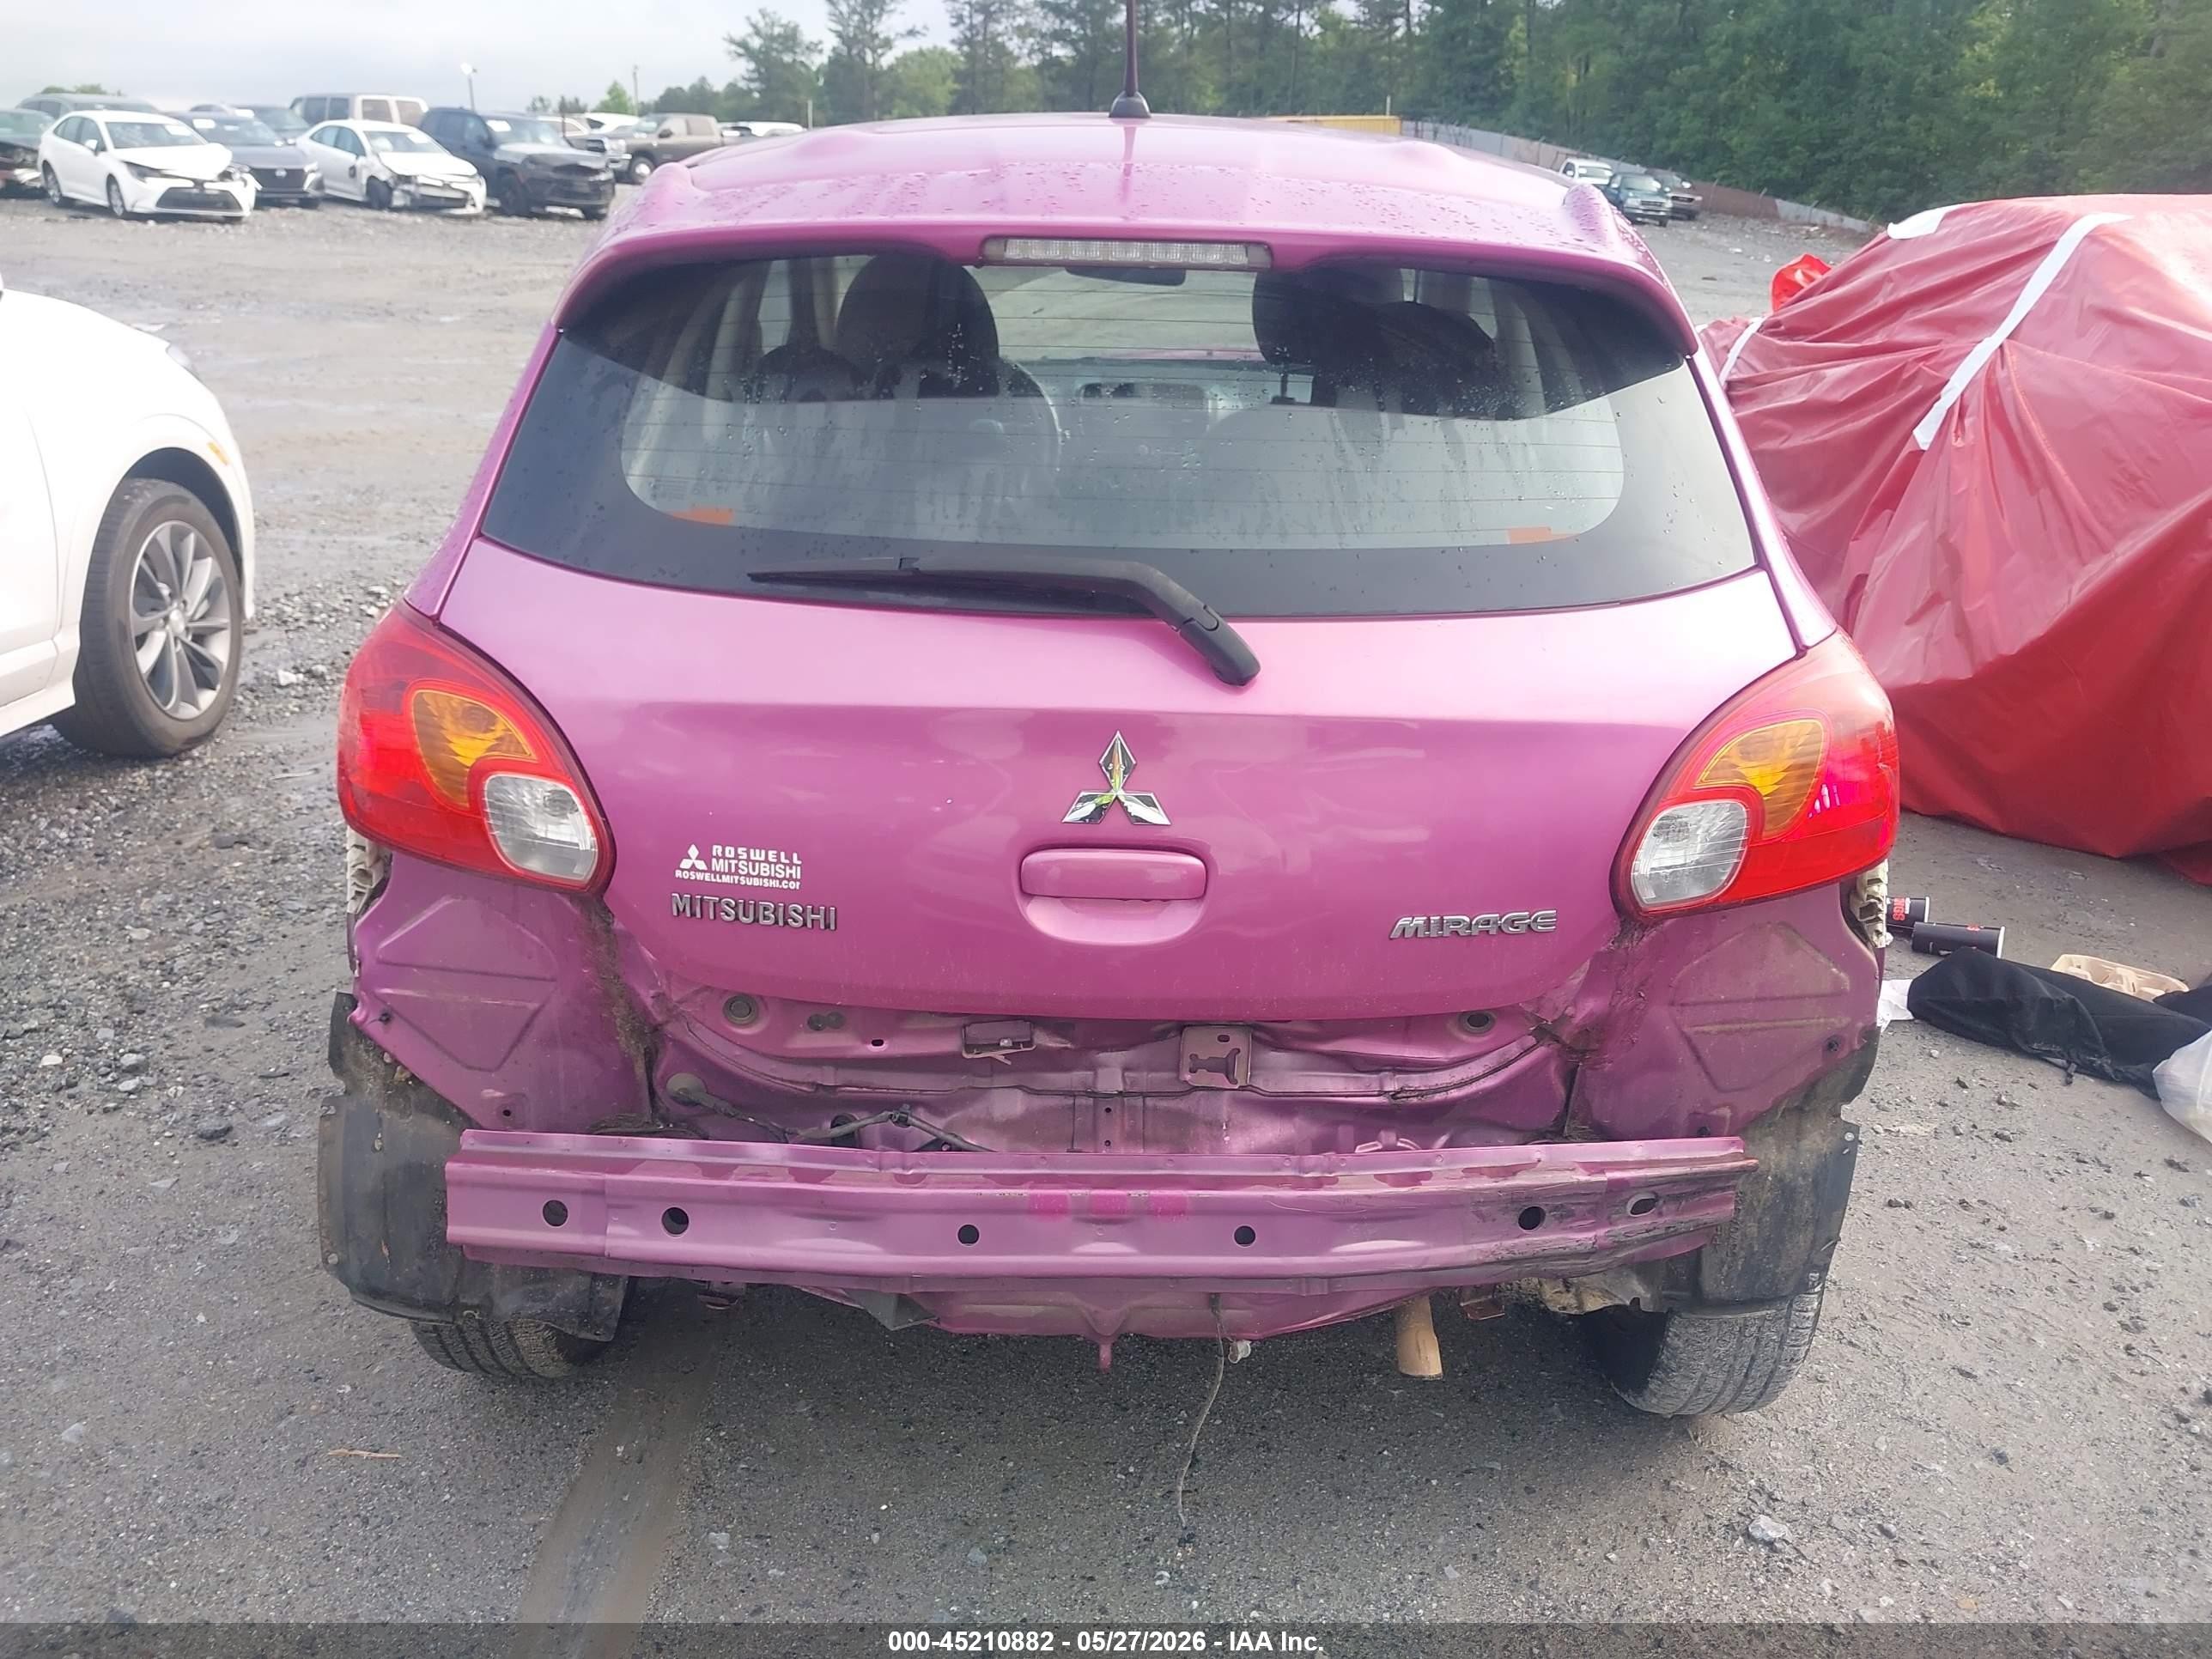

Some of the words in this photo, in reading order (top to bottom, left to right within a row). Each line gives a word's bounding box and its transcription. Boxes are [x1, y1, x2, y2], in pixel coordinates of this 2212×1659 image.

[712, 844, 802, 865] ROSWELL
[711, 858, 801, 879] MITSUBISHI
[672, 893, 836, 930] MITSUBISHI
[1389, 909, 1557, 939] MIRAGE
